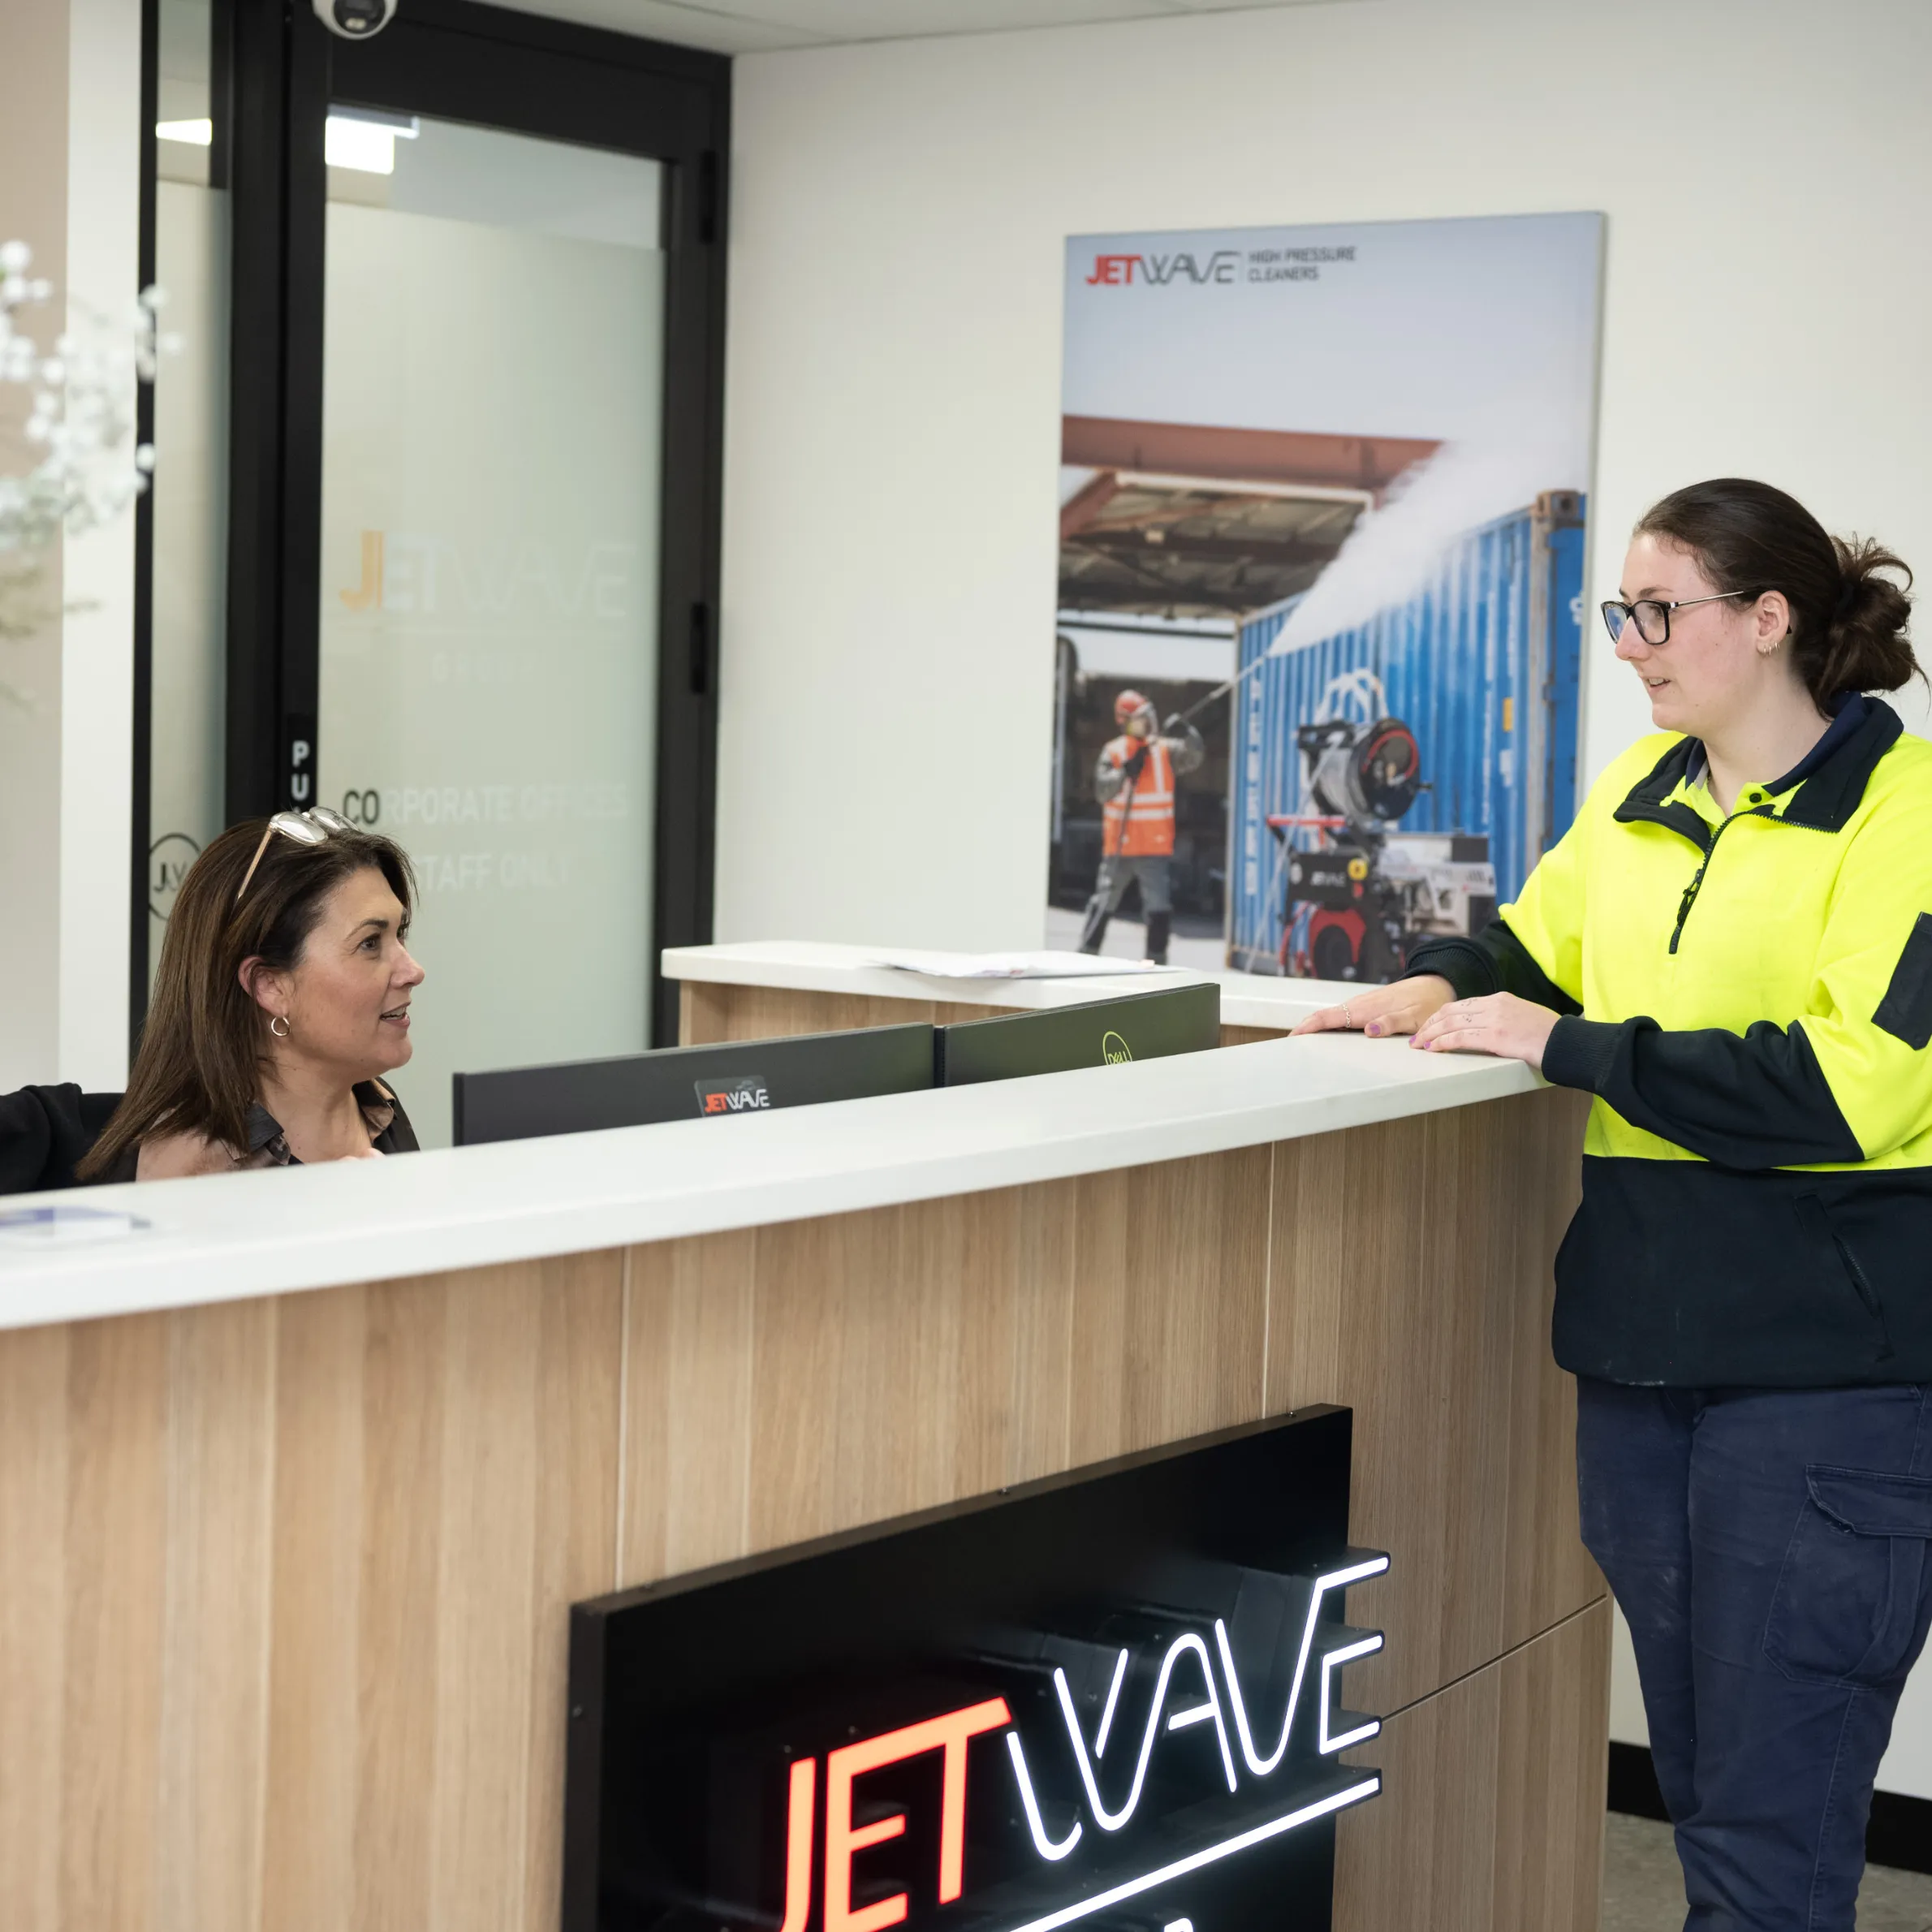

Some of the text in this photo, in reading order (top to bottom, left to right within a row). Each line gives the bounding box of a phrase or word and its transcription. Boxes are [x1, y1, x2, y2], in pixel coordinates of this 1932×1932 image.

[1086, 252, 1240, 285] JETWAVE
[1249, 246, 1356, 263] HIGH PRESSURE
[1248, 265, 1319, 282] CLEANERS
[338, 529, 637, 618] JETWAVE
[343, 783, 513, 826] CORPORATE
[704, 1088, 770, 1113] JETWAVE
[779, 1555, 1390, 1932] JETWAVE
